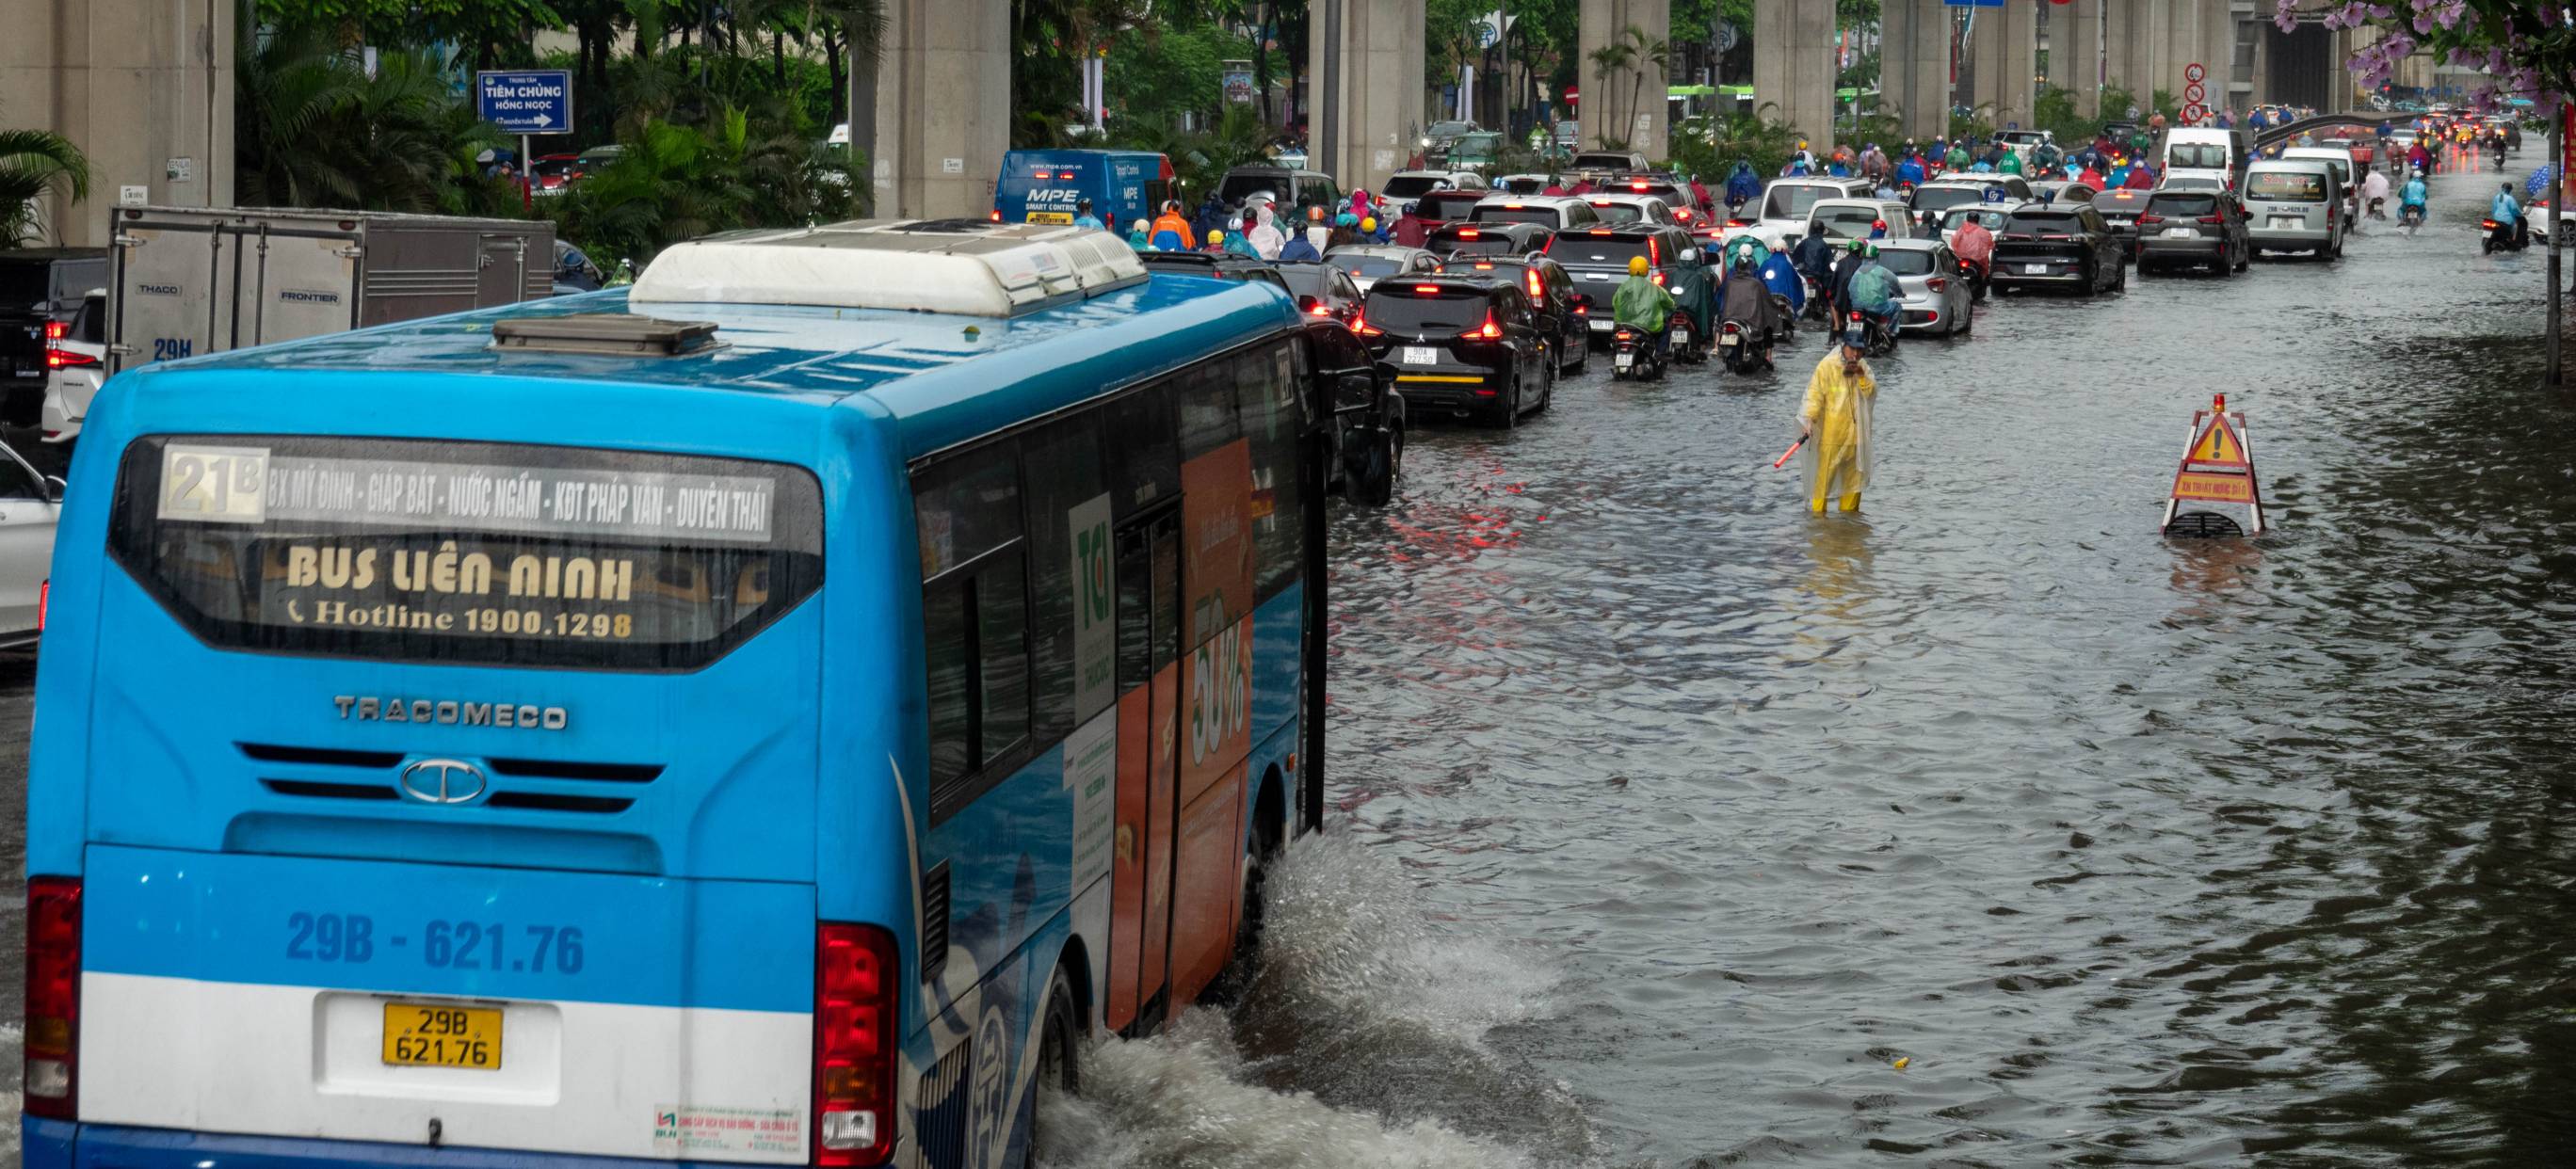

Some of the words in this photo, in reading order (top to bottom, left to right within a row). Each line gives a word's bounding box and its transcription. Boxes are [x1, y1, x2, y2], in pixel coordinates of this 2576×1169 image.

[485, 85, 515, 98] TIÊM
[1027, 189, 1080, 203] MPE
[1123, 187, 1138, 200] MPE
[1049, 203, 1078, 212] CONTROL
[139, 285, 178, 295] THACO
[282, 292, 339, 303] FRONTIER
[154, 338, 192, 361] 29H
[268, 468, 288, 507] BX
[368, 467, 404, 513] GIÁP
[587, 477, 628, 523] PHÁP
[677, 486, 730, 531] DUYÊN
[732, 485, 766, 532] THÁI
[287, 545, 377, 589] BUS
[393, 540, 491, 596] LIÊN
[508, 553, 633, 601] NINH
[315, 601, 454, 631] Hotline
[464, 608, 632, 638] 1900.1298
[335, 696, 569, 730] TRACOMECO
[286, 911, 374, 965] 29B
[425, 919, 584, 975] 621.76
[418, 1009, 468, 1036] 29B
[396, 1037, 488, 1065] 621.76
